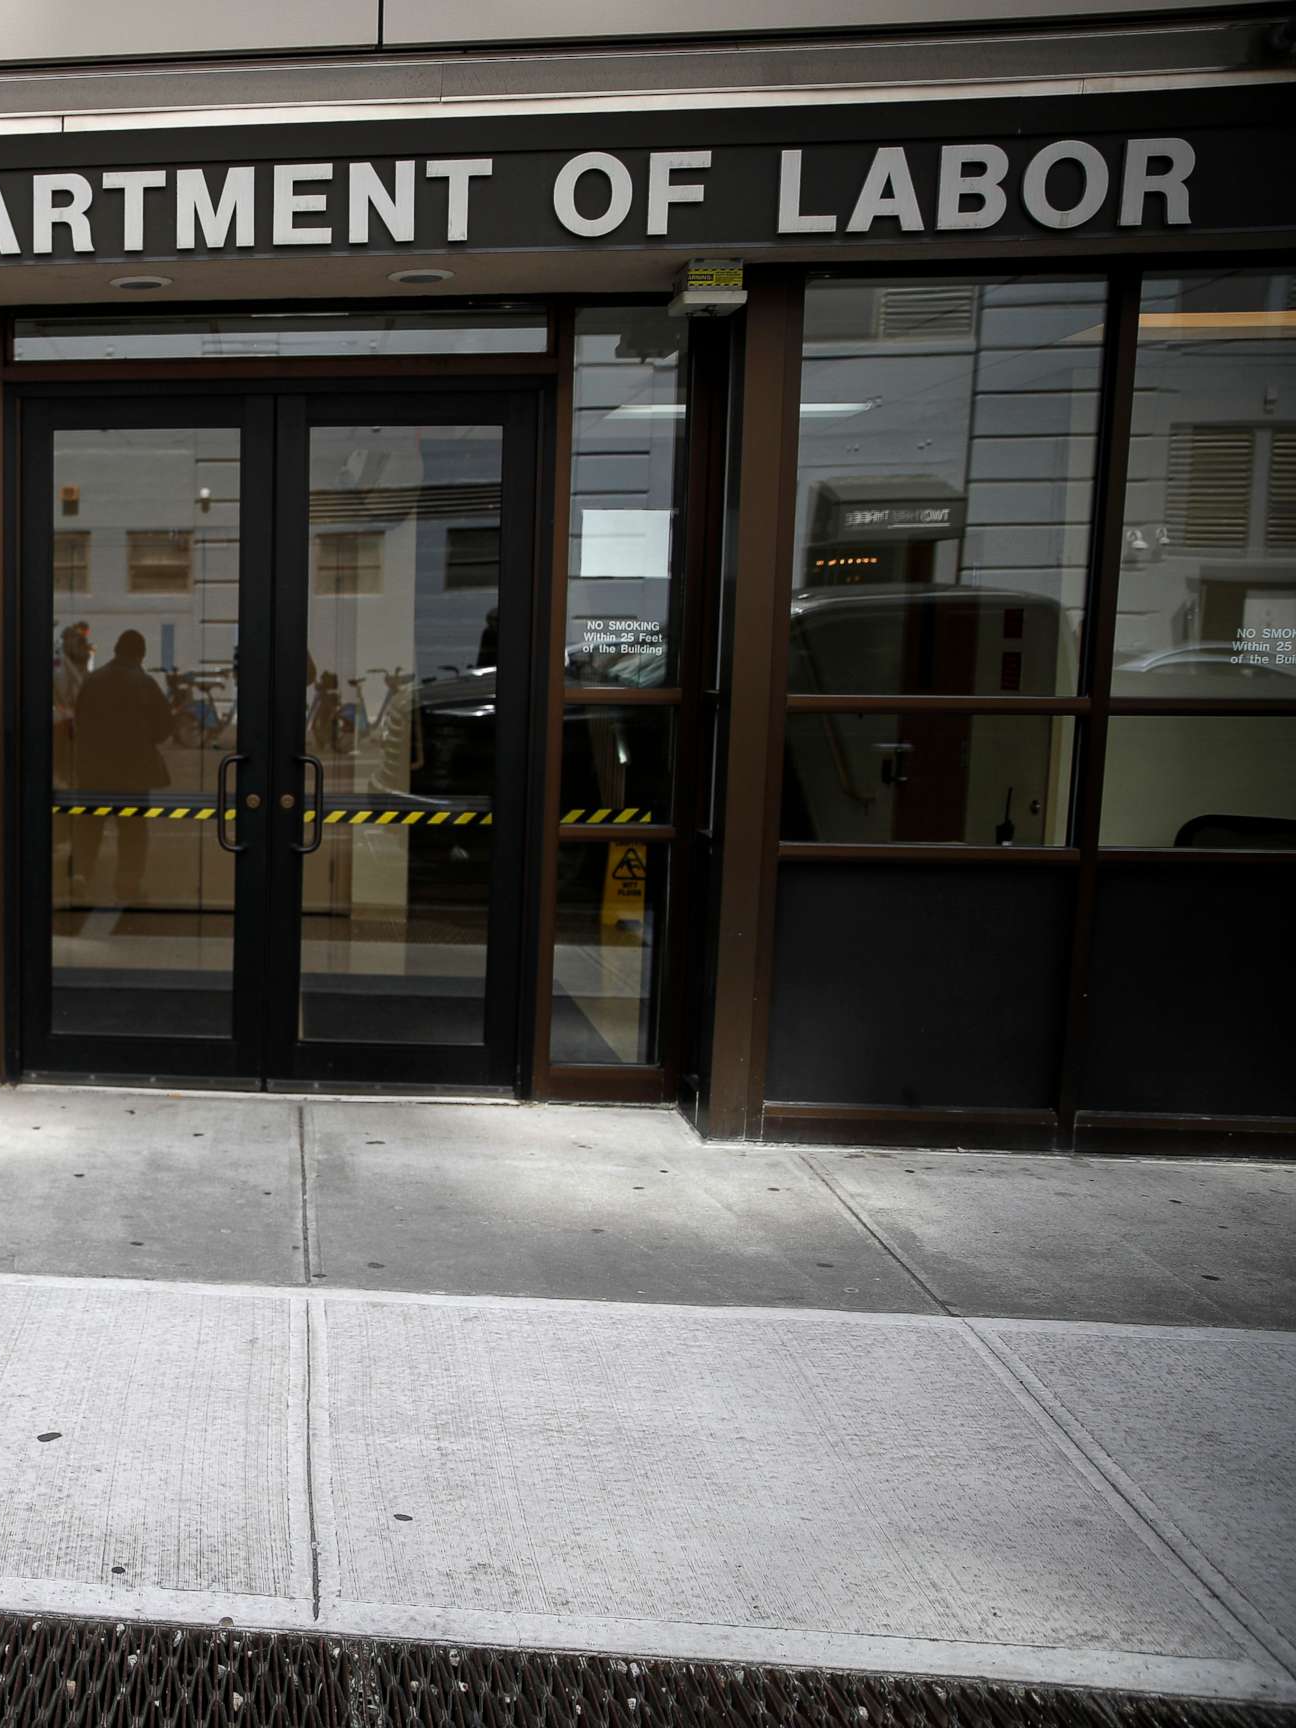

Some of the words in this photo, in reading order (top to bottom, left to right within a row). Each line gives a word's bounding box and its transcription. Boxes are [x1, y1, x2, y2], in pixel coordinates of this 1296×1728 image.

[554, 151, 712, 236] OF
[778, 138, 1195, 233] LABOR
[587, 621, 603, 630] NO
[608, 620, 660, 631] SMOKING
[583, 632, 616, 642] Within
[620, 633, 635, 642] 25
[639, 633, 662, 643] Feet
[1236, 628, 1256, 639] NO
[582, 644, 593, 653] of
[599, 644, 616, 653] the
[621, 644, 663, 656] Building
[1232, 641, 1270, 652] Within
[1276, 641, 1292, 652] 25
[1230, 654, 1244, 664] of
[1249, 654, 1270, 664] the
